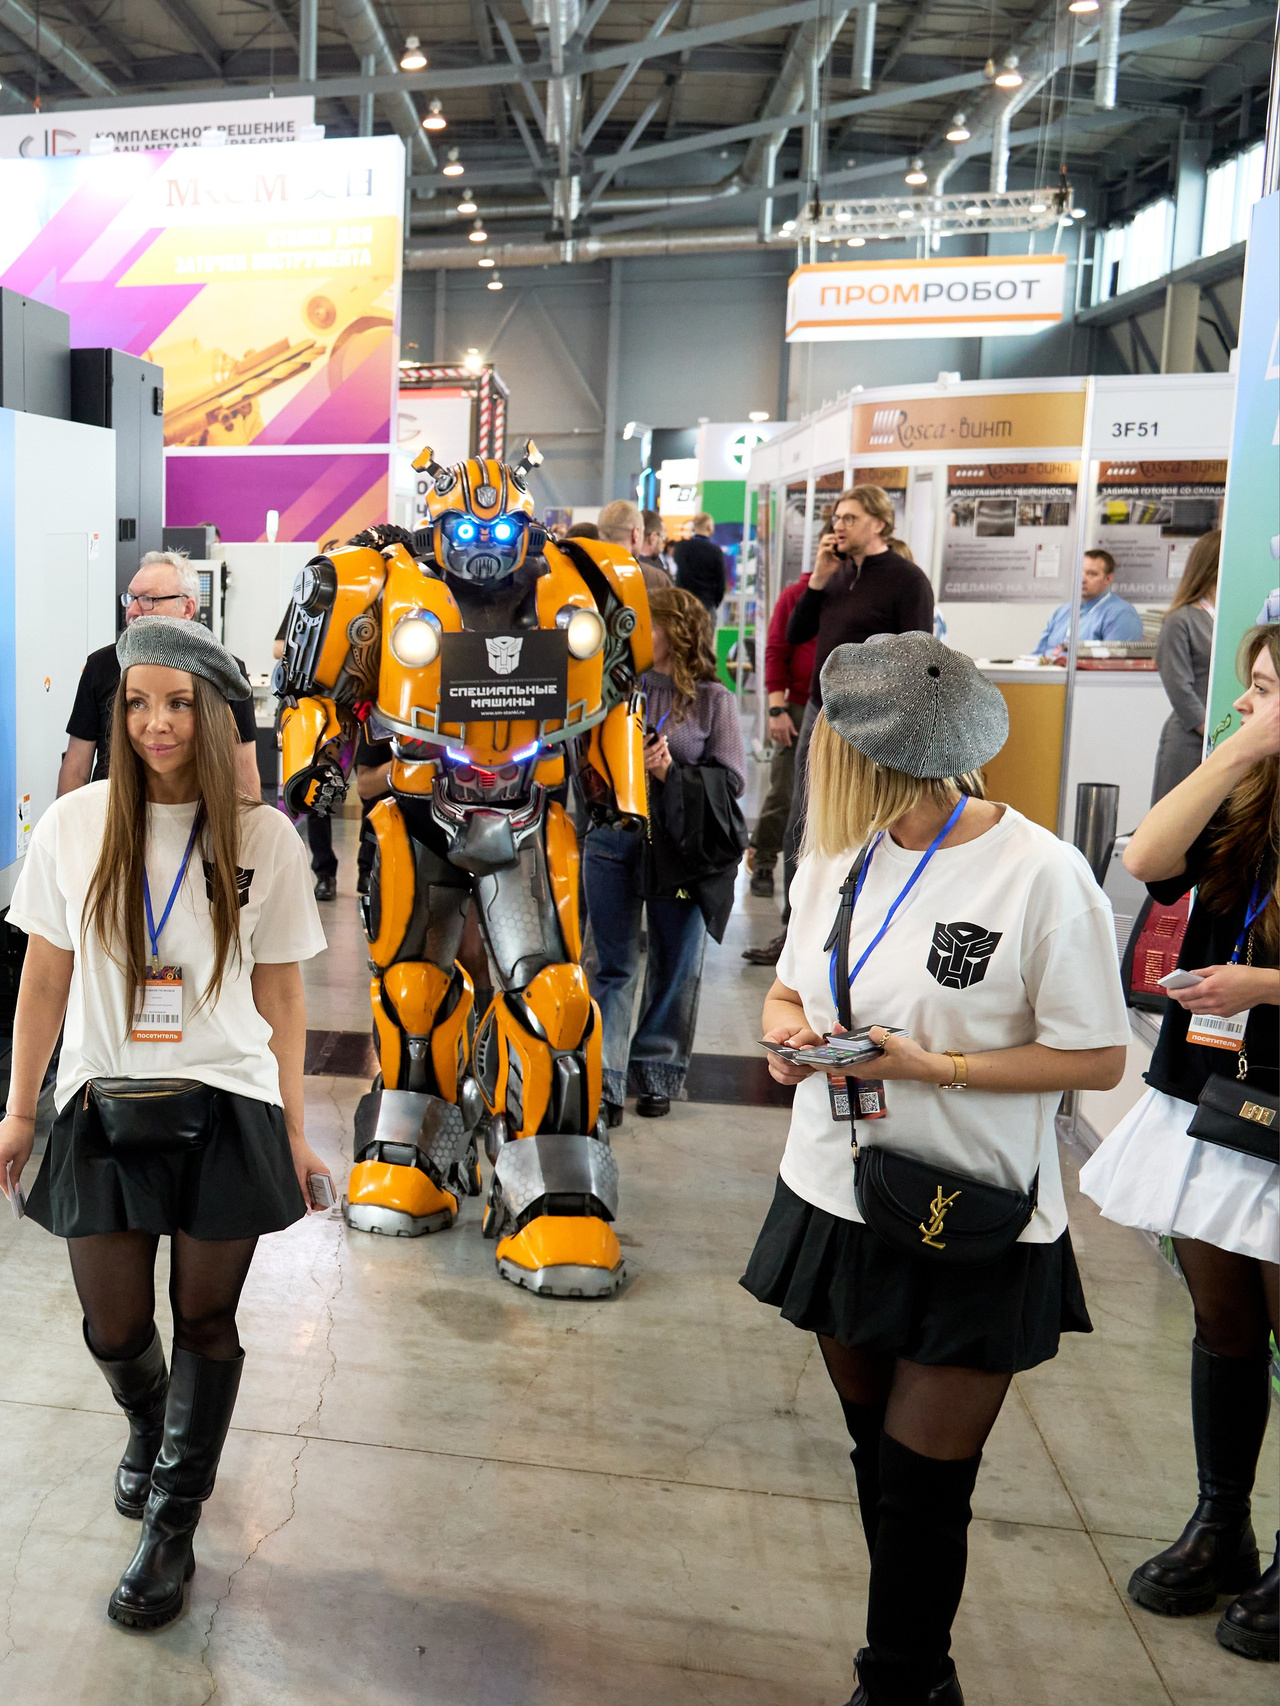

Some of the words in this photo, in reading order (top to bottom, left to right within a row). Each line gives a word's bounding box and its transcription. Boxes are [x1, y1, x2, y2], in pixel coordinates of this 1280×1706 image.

[335, 226, 373, 248] ДЛЯ
[174, 254, 248, 274] ЗАТОЧКИ
[252, 249, 372, 271] ИНСТРУМЕНТА
[820, 279, 1040, 306] ПРОМРОБОТ
[1112, 421, 1159, 438] 3F51
[1141, 486, 1178, 495] ГОТОВОЕ
[1111, 582, 1154, 593] ЕЛАНО
[449, 685, 558, 697] СПЕЦИАЛЬНЫЕ
[471, 697, 535, 708] МАШИНЫ
[1191, 1034, 1237, 1048] посетитель
